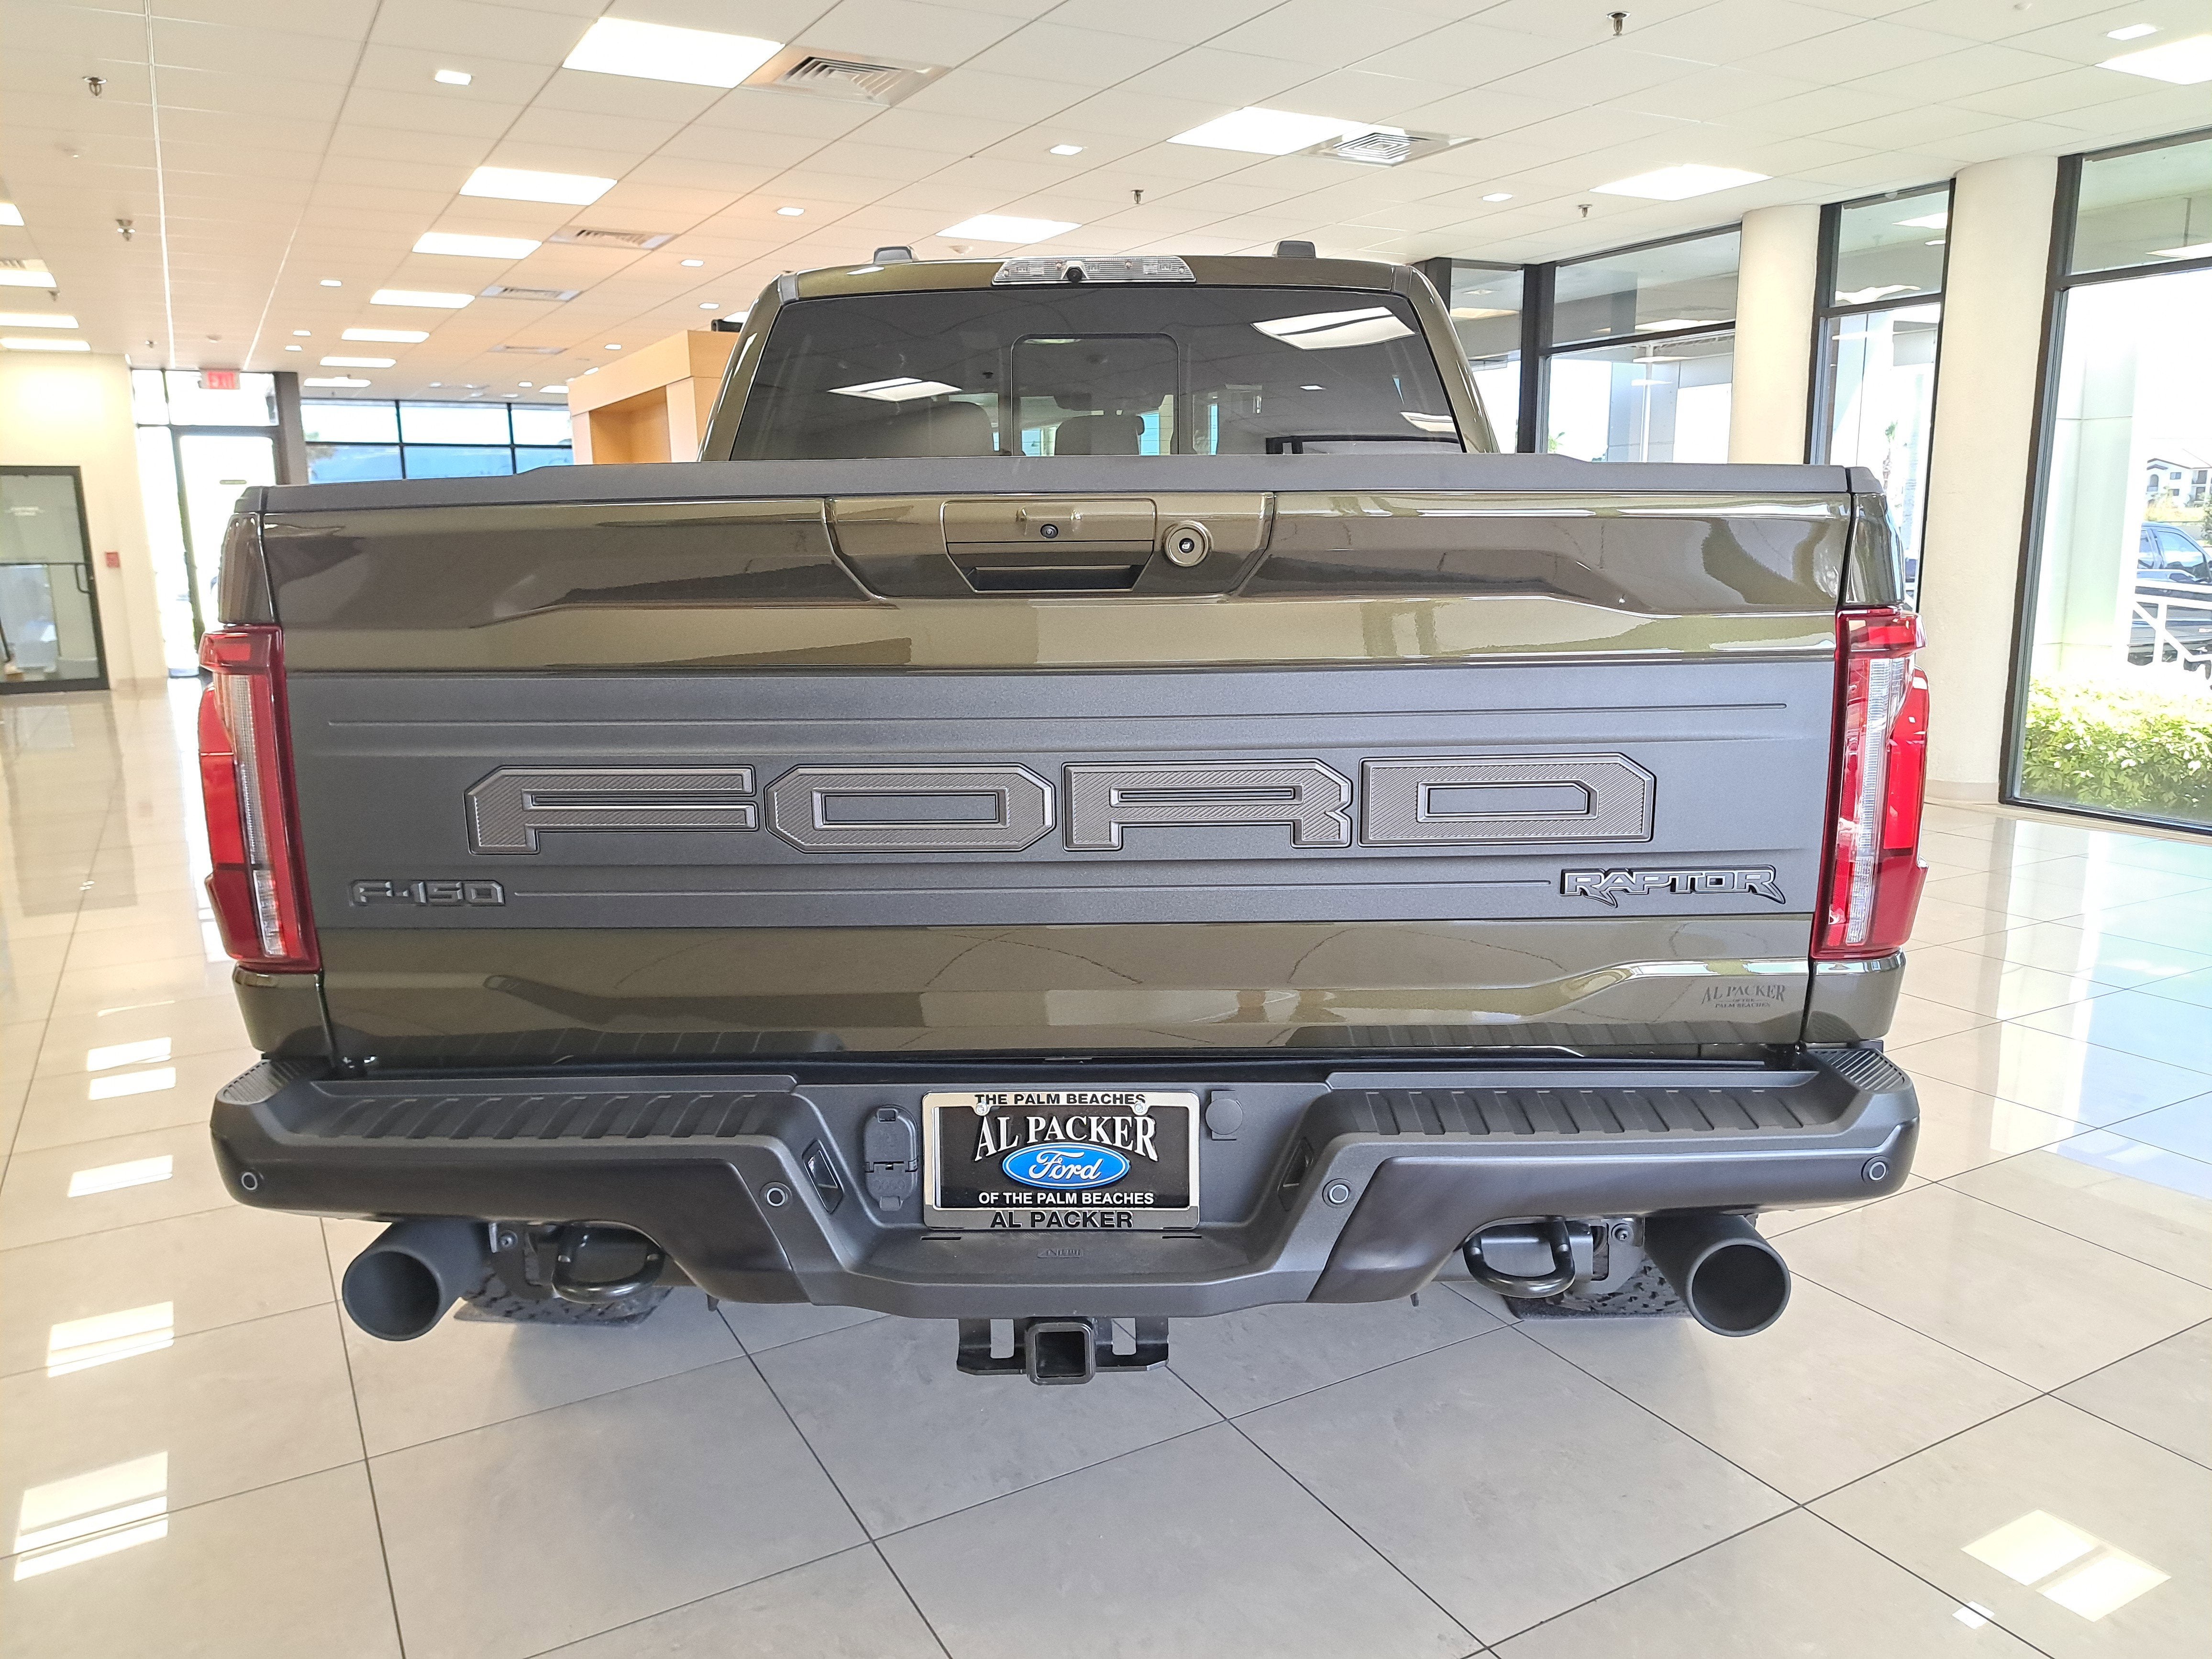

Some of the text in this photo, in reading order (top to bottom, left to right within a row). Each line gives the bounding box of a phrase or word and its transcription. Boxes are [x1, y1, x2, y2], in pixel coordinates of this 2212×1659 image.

[464, 752, 1656, 855] FORD
[349, 880, 506, 907] F-150
[1560, 865, 1786, 908] RAPTOR
[1701, 984, 1785, 1005] AL PACKER
[974, 1094, 1146, 1105] THE PALM BEACHES
[974, 1115, 1158, 1162] AL PACKER
[1029, 1150, 1103, 1180] Ford
[978, 1192, 1154, 1205] OF THE PALM BEACHES
[990, 1210, 1133, 1228] AL PACKER
